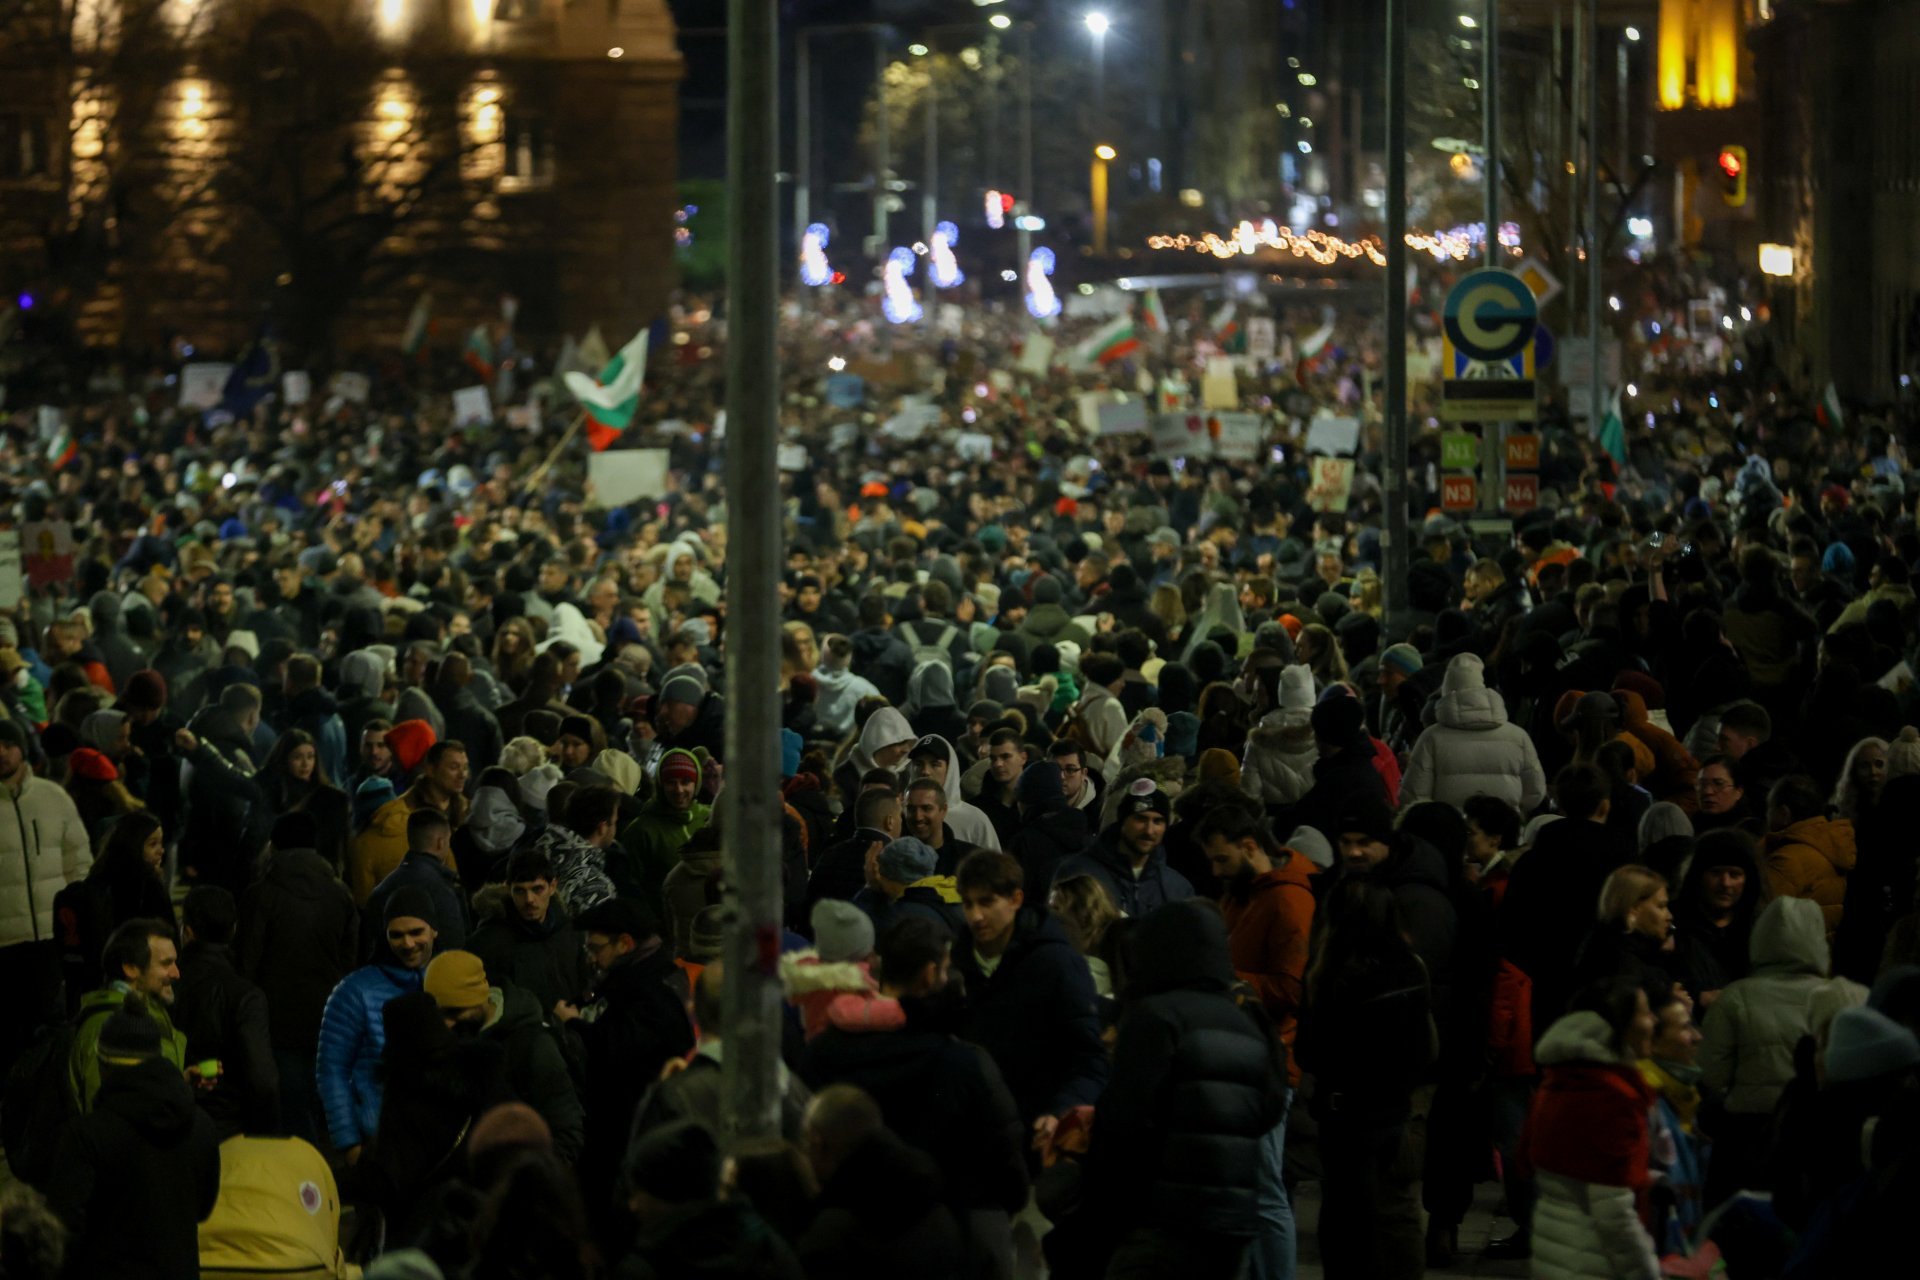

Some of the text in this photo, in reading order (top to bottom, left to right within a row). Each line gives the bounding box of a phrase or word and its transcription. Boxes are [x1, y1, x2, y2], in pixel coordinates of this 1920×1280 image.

[1447, 443, 1471, 459] N1
[1509, 444, 1535, 459] N2
[1446, 485, 1471, 502] N3
[1508, 485, 1533, 501] N4
